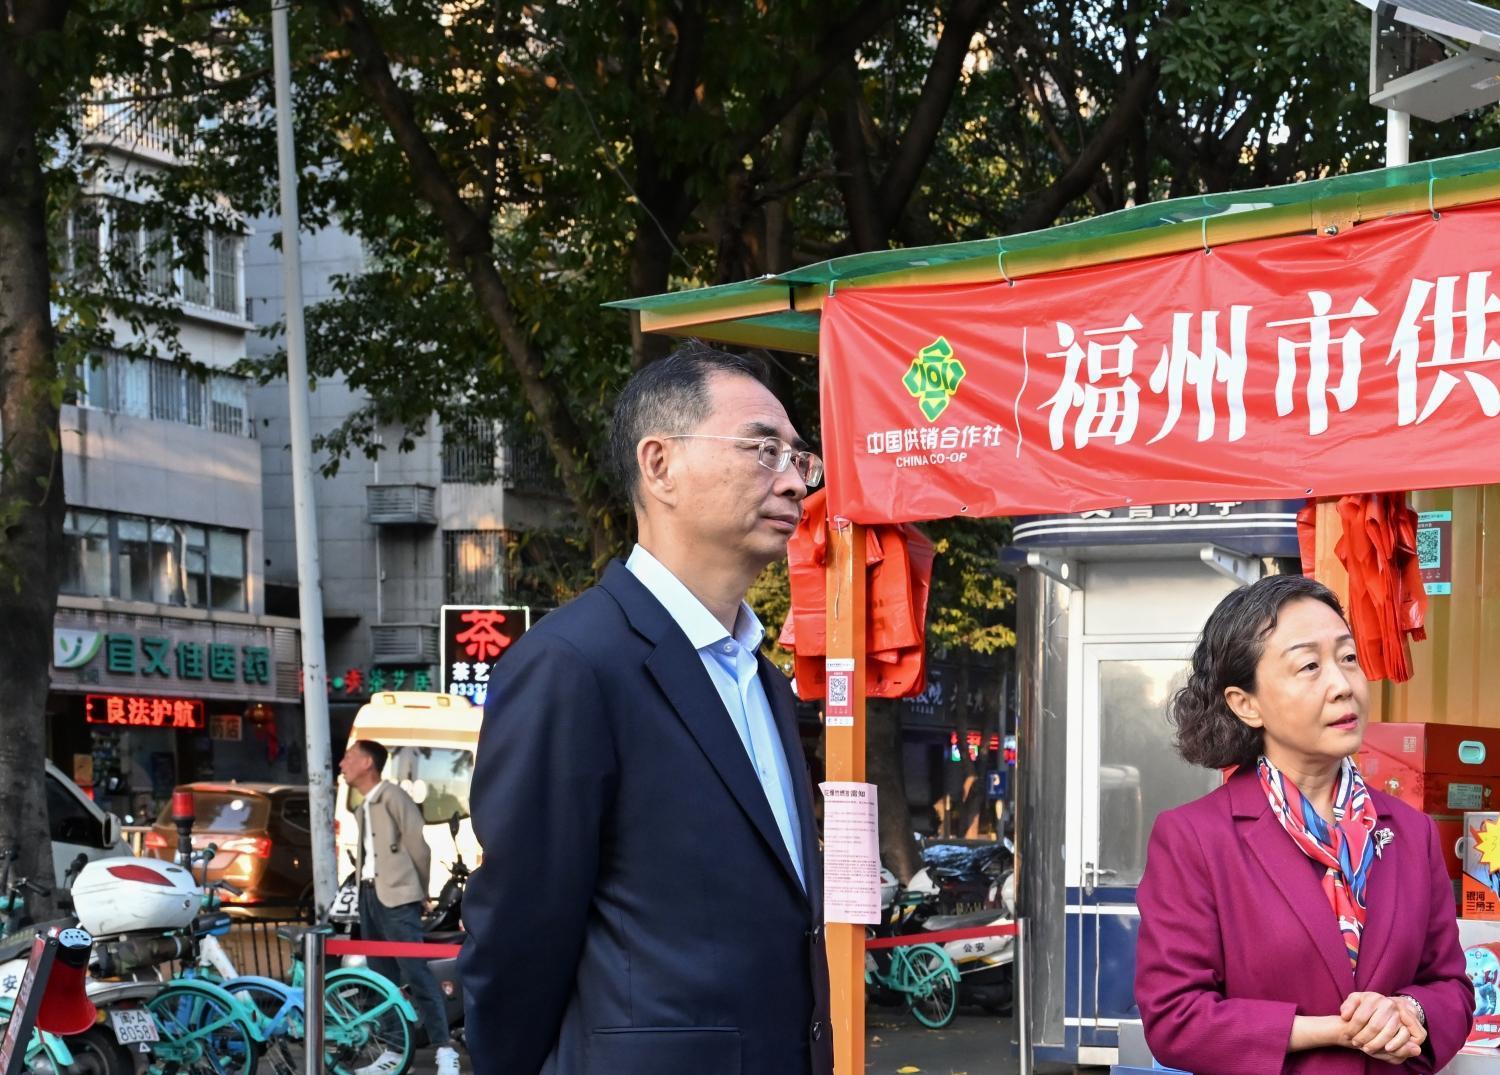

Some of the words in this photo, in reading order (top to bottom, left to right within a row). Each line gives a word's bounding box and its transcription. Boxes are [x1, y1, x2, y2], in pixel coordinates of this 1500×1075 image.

[867, 424, 1003, 456] 中国供销合作社
[896, 456, 929, 468] CHINA
[930, 452, 967, 465] CO-OP
[456, 610, 513, 662] 茶
[452, 662, 497, 682] 茶艺
[106, 697, 196, 728] 良法护航
[964, 942, 986, 953] 公安
